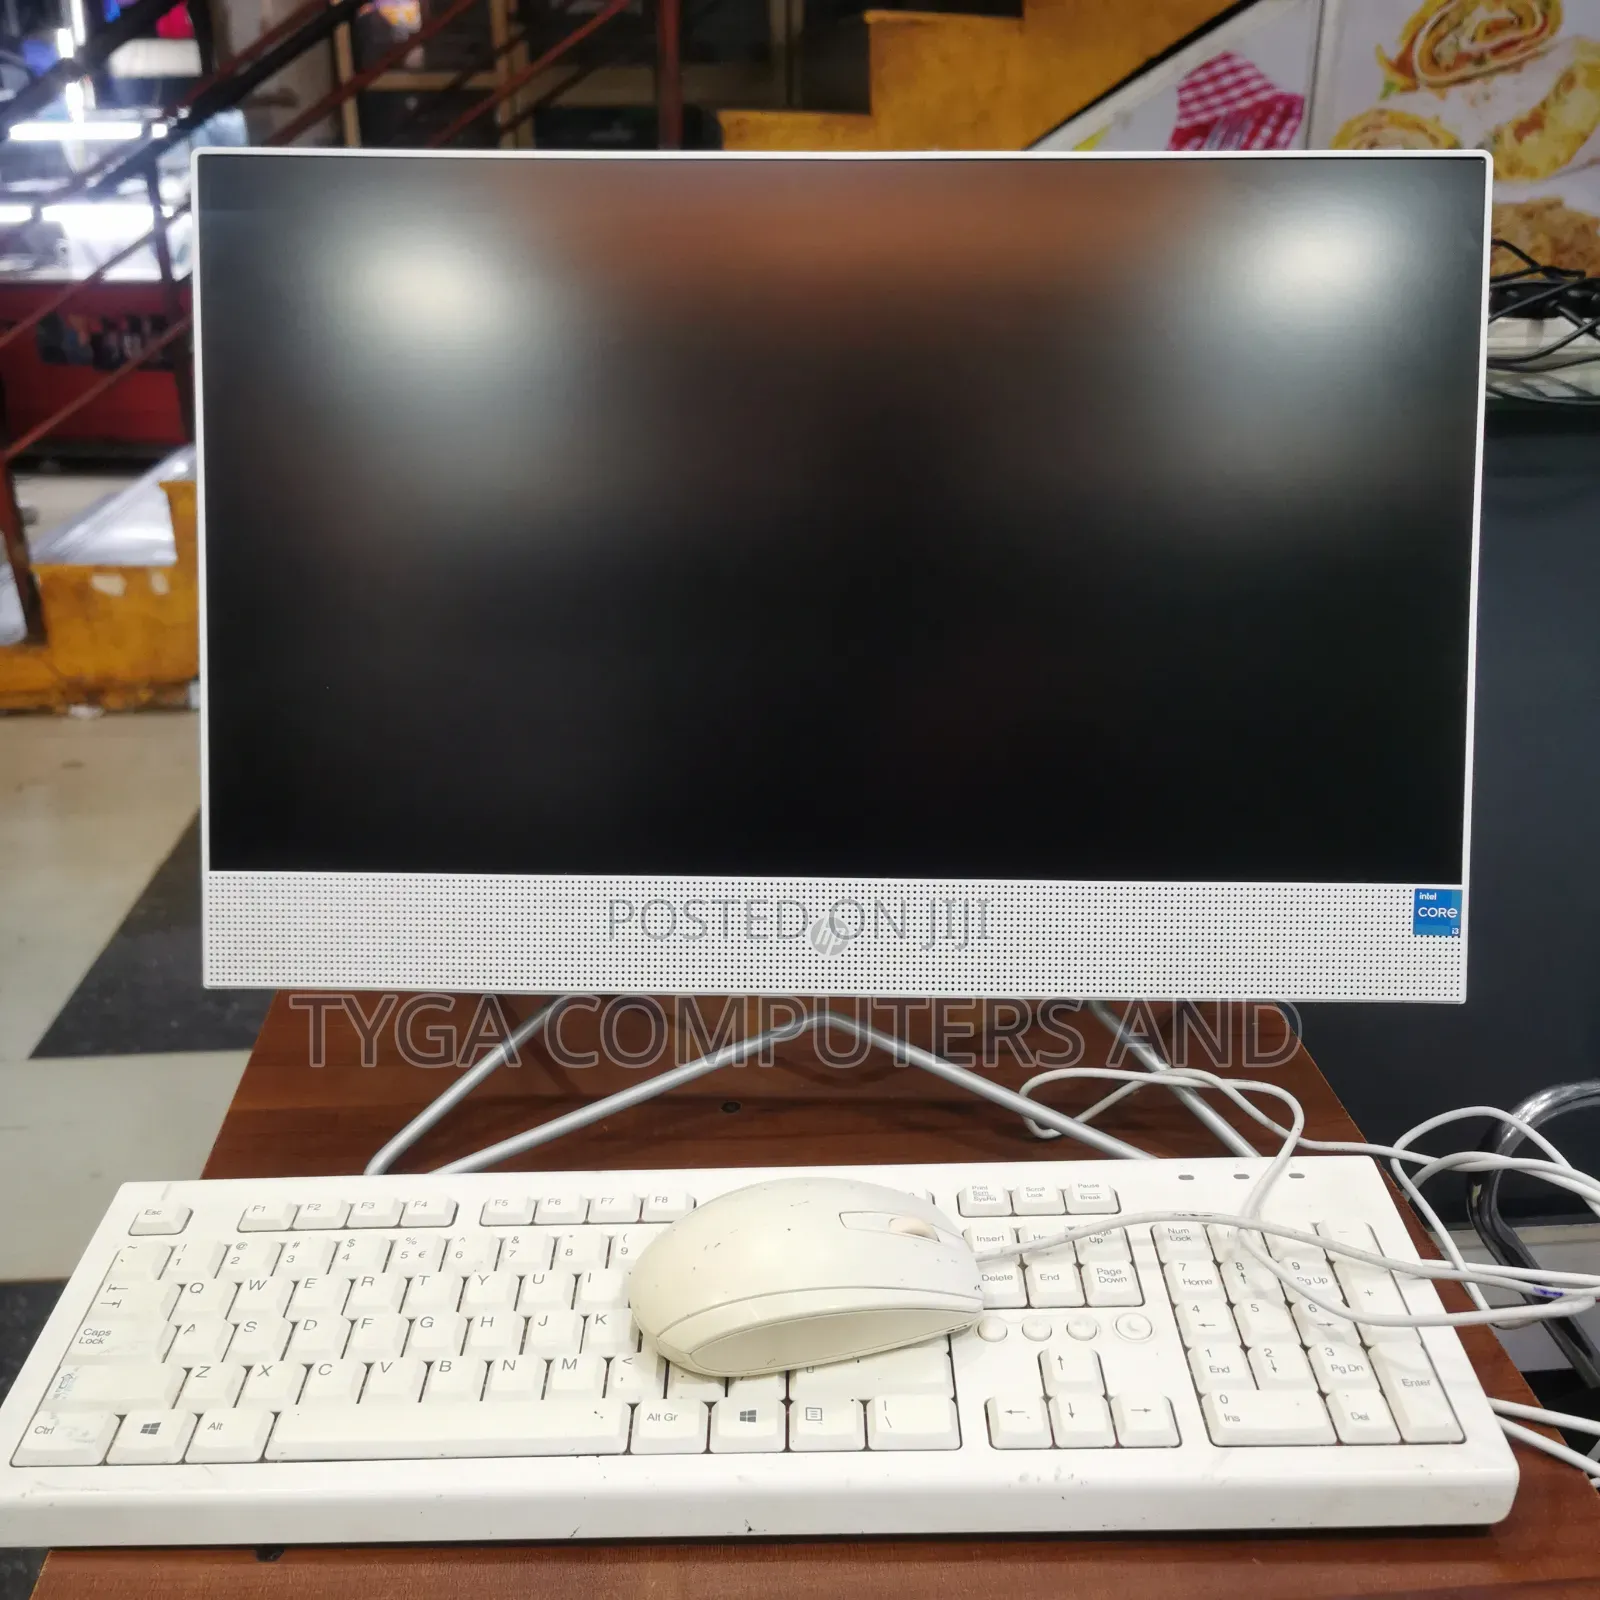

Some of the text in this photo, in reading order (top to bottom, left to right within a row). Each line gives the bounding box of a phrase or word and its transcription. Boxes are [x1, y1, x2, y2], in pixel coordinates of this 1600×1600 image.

[1419, 892, 1437, 900] intel
[1451, 927, 1459, 935] i3
[413, 1200, 428, 1208] F4
[494, 1199, 509, 1207] F5
[547, 1197, 562, 1206] F6
[600, 1197, 615, 1205] F7
[654, 1195, 669, 1204] F8
[252, 1204, 266, 1213] F1
[306, 1203, 322, 1211] F2
[360, 1201, 376, 1210] F3
[144, 1208, 163, 1216] Esc
[1167, 1227, 1190, 1235] Num
[976, 1234, 1005, 1242] Insert
[1087, 1234, 1104, 1245] Up
[399, 1250, 409, 1260] 5
[455, 1250, 464, 1259] 6
[508, 1249, 517, 1258] 7
[564, 1248, 574, 1257] 8
[620, 1246, 629, 1256] 9
[229, 1256, 241, 1265] 2
[285, 1254, 296, 1264] 3
[341, 1253, 350, 1262] 4
[1178, 1262, 1187, 1272] 7
[1234, 1261, 1245, 1271] 8
[1291, 1261, 1301, 1271] 9
[1039, 1273, 1060, 1281] End
[1096, 1267, 1123, 1277] Page
[360, 1275, 375, 1287] R
[418, 1274, 431, 1286] T
[477, 1274, 490, 1286] Y
[532, 1273, 545, 1285] U
[981, 1273, 1014, 1282] Delete
[1098, 1274, 1128, 1284] Down
[1182, 1278, 1213, 1286] Home
[1312, 1276, 1329, 1285] Up
[249, 1279, 268, 1291] W
[303, 1277, 318, 1289] E
[189, 1282, 205, 1295] Q
[1191, 1304, 1201, 1313] 4
[1250, 1303, 1260, 1313] 5
[1307, 1303, 1319, 1313] 6
[360, 1317, 374, 1330] F
[419, 1315, 435, 1329] G
[480, 1316, 495, 1328] H
[537, 1315, 549, 1327] J
[594, 1313, 608, 1325] K
[183, 1323, 196, 1335] A
[243, 1320, 258, 1333] S
[302, 1319, 318, 1331] D
[82, 1327, 112, 1338] Caps
[78, 1336, 106, 1346] Lock
[1263, 1347, 1274, 1358] 2
[1324, 1346, 1335, 1357] 3
[380, 1361, 394, 1374] V
[438, 1360, 452, 1373] B
[502, 1359, 517, 1372] N
[561, 1357, 578, 1370] M
[194, 1365, 212, 1379] Z
[257, 1364, 273, 1377] X
[317, 1363, 333, 1376] C
[1208, 1365, 1231, 1374] End
[1330, 1363, 1364, 1375] Pg Dn
[1401, 1378, 1431, 1388] Enter
[1219, 1393, 1229, 1405] 0
[646, 1412, 679, 1422] Alt Gr
[1223, 1412, 1241, 1423] Ins
[1350, 1411, 1370, 1421] Del
[33, 1425, 56, 1435] Ctrl
[207, 1421, 224, 1431] Alt
